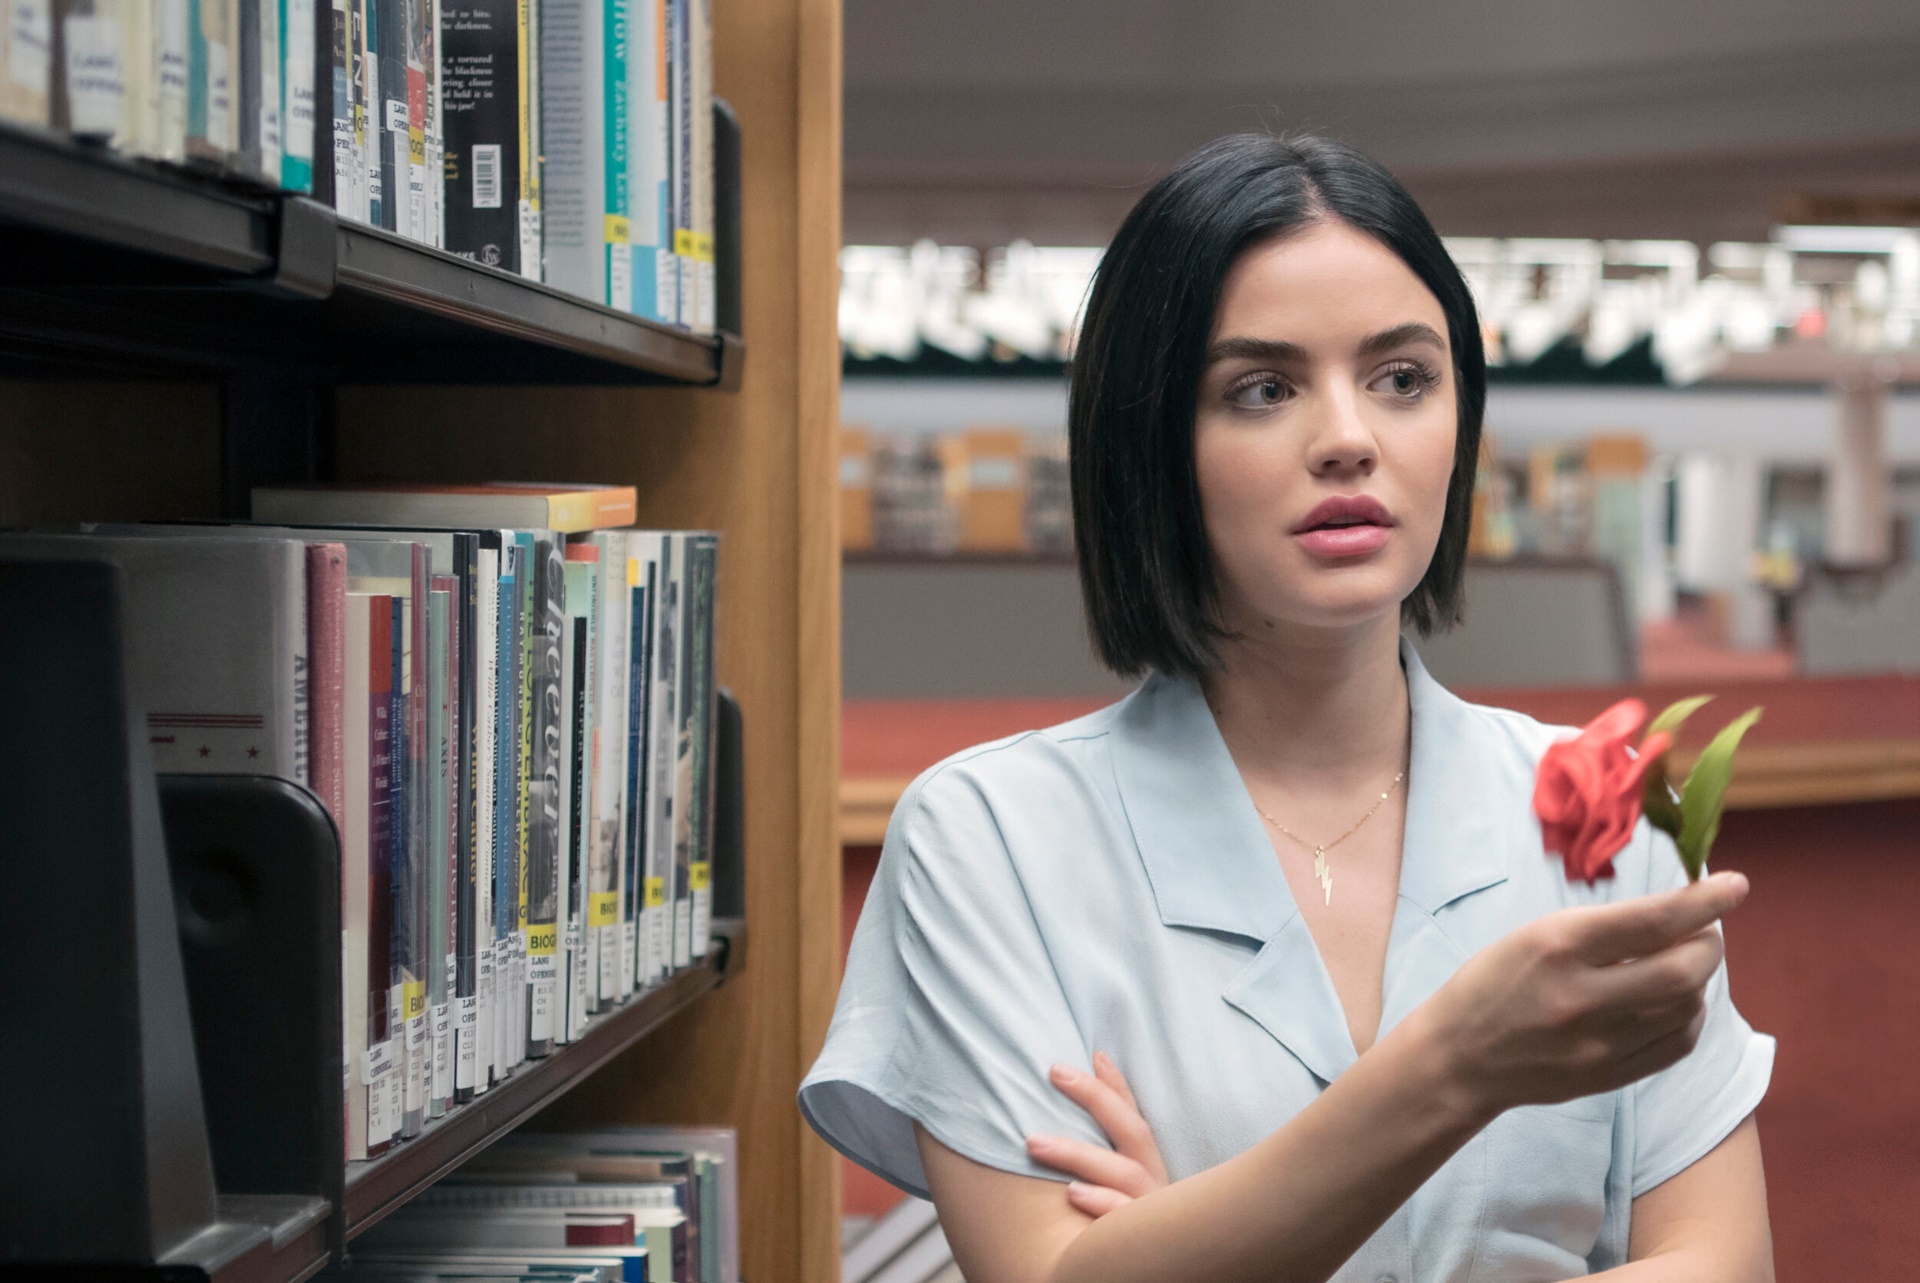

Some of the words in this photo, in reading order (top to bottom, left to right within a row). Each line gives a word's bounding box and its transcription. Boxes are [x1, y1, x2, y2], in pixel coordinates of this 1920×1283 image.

[454, 21, 492, 30] darkness.
[457, 54, 494, 64] tortured
[468, 79, 493, 87] closer
[611, 80, 628, 163] Zachary
[517, 611, 525, 710] RAYMOND
[544, 548, 565, 837] Cheever
[486, 704, 494, 763] Cather's
[503, 679, 511, 789] COMPANION
[577, 690, 585, 766] RUPERT
[503, 797, 510, 819] TO
[515, 724, 523, 834] CHANDLER
[470, 799, 478, 886] Cather
[532, 956, 550, 966] LANG
